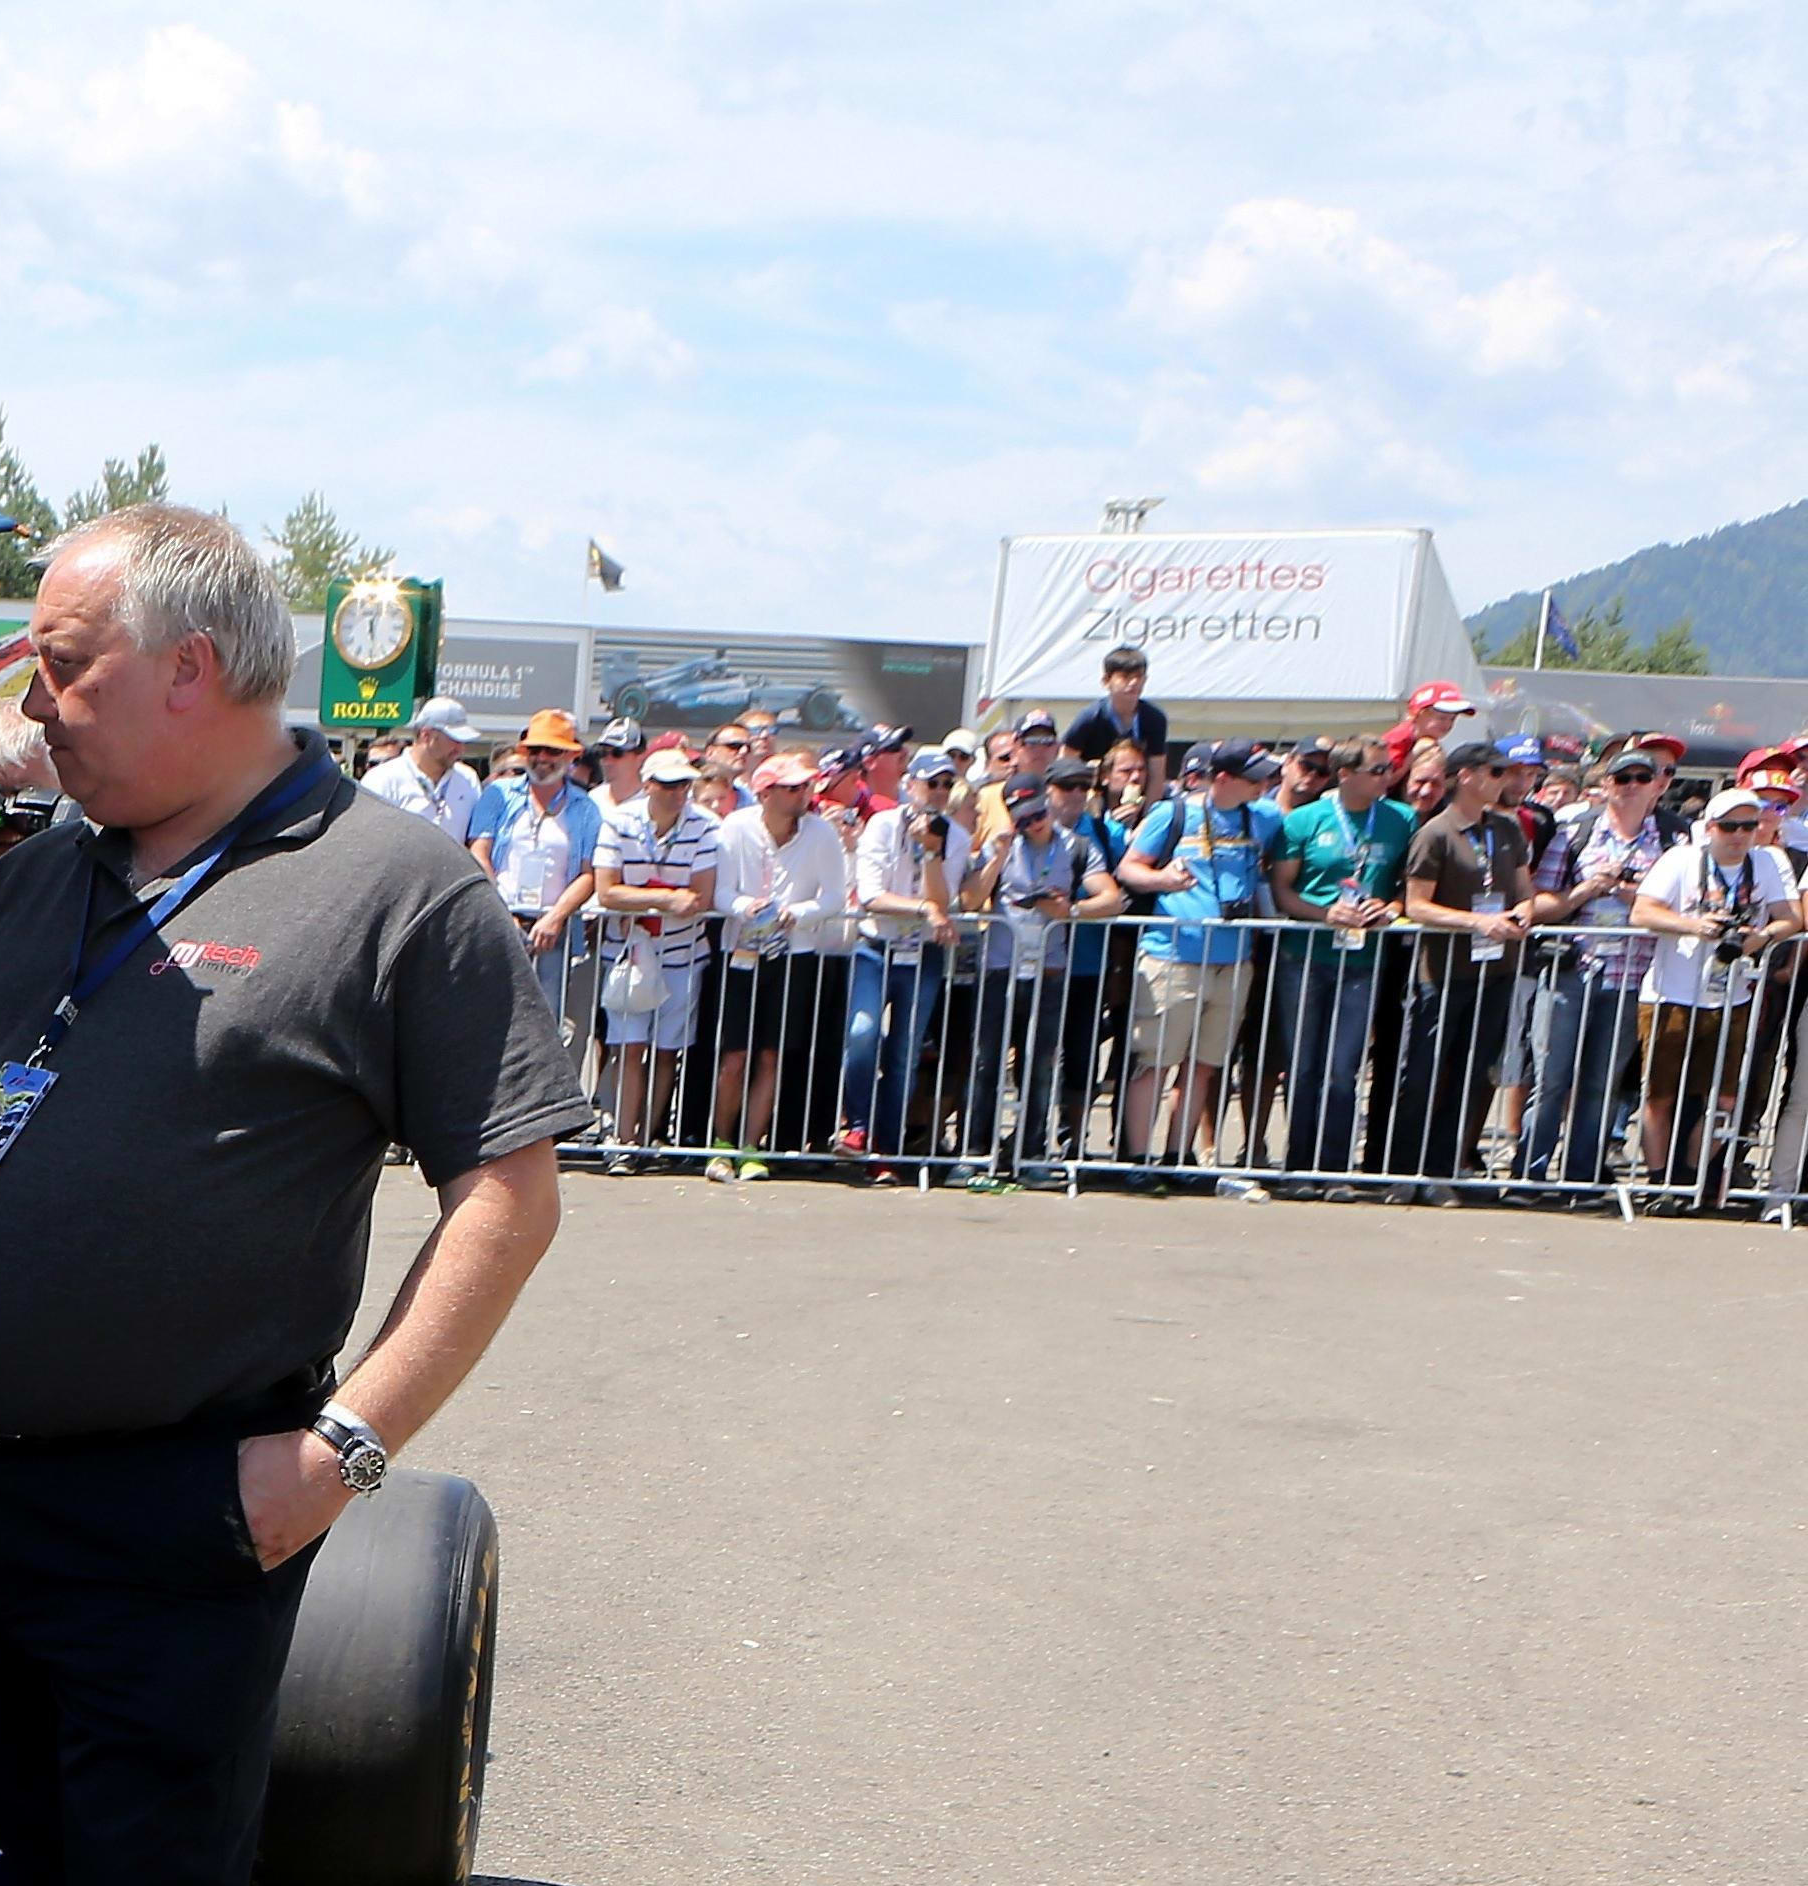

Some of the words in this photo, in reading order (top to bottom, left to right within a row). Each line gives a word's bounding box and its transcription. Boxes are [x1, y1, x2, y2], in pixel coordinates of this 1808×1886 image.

[1086, 559, 1325, 601] Cigarettes
[1082, 607, 1322, 649] Zigaretten
[437, 681, 522, 698] CHANDISE
[333, 701, 401, 719] ROLEX
